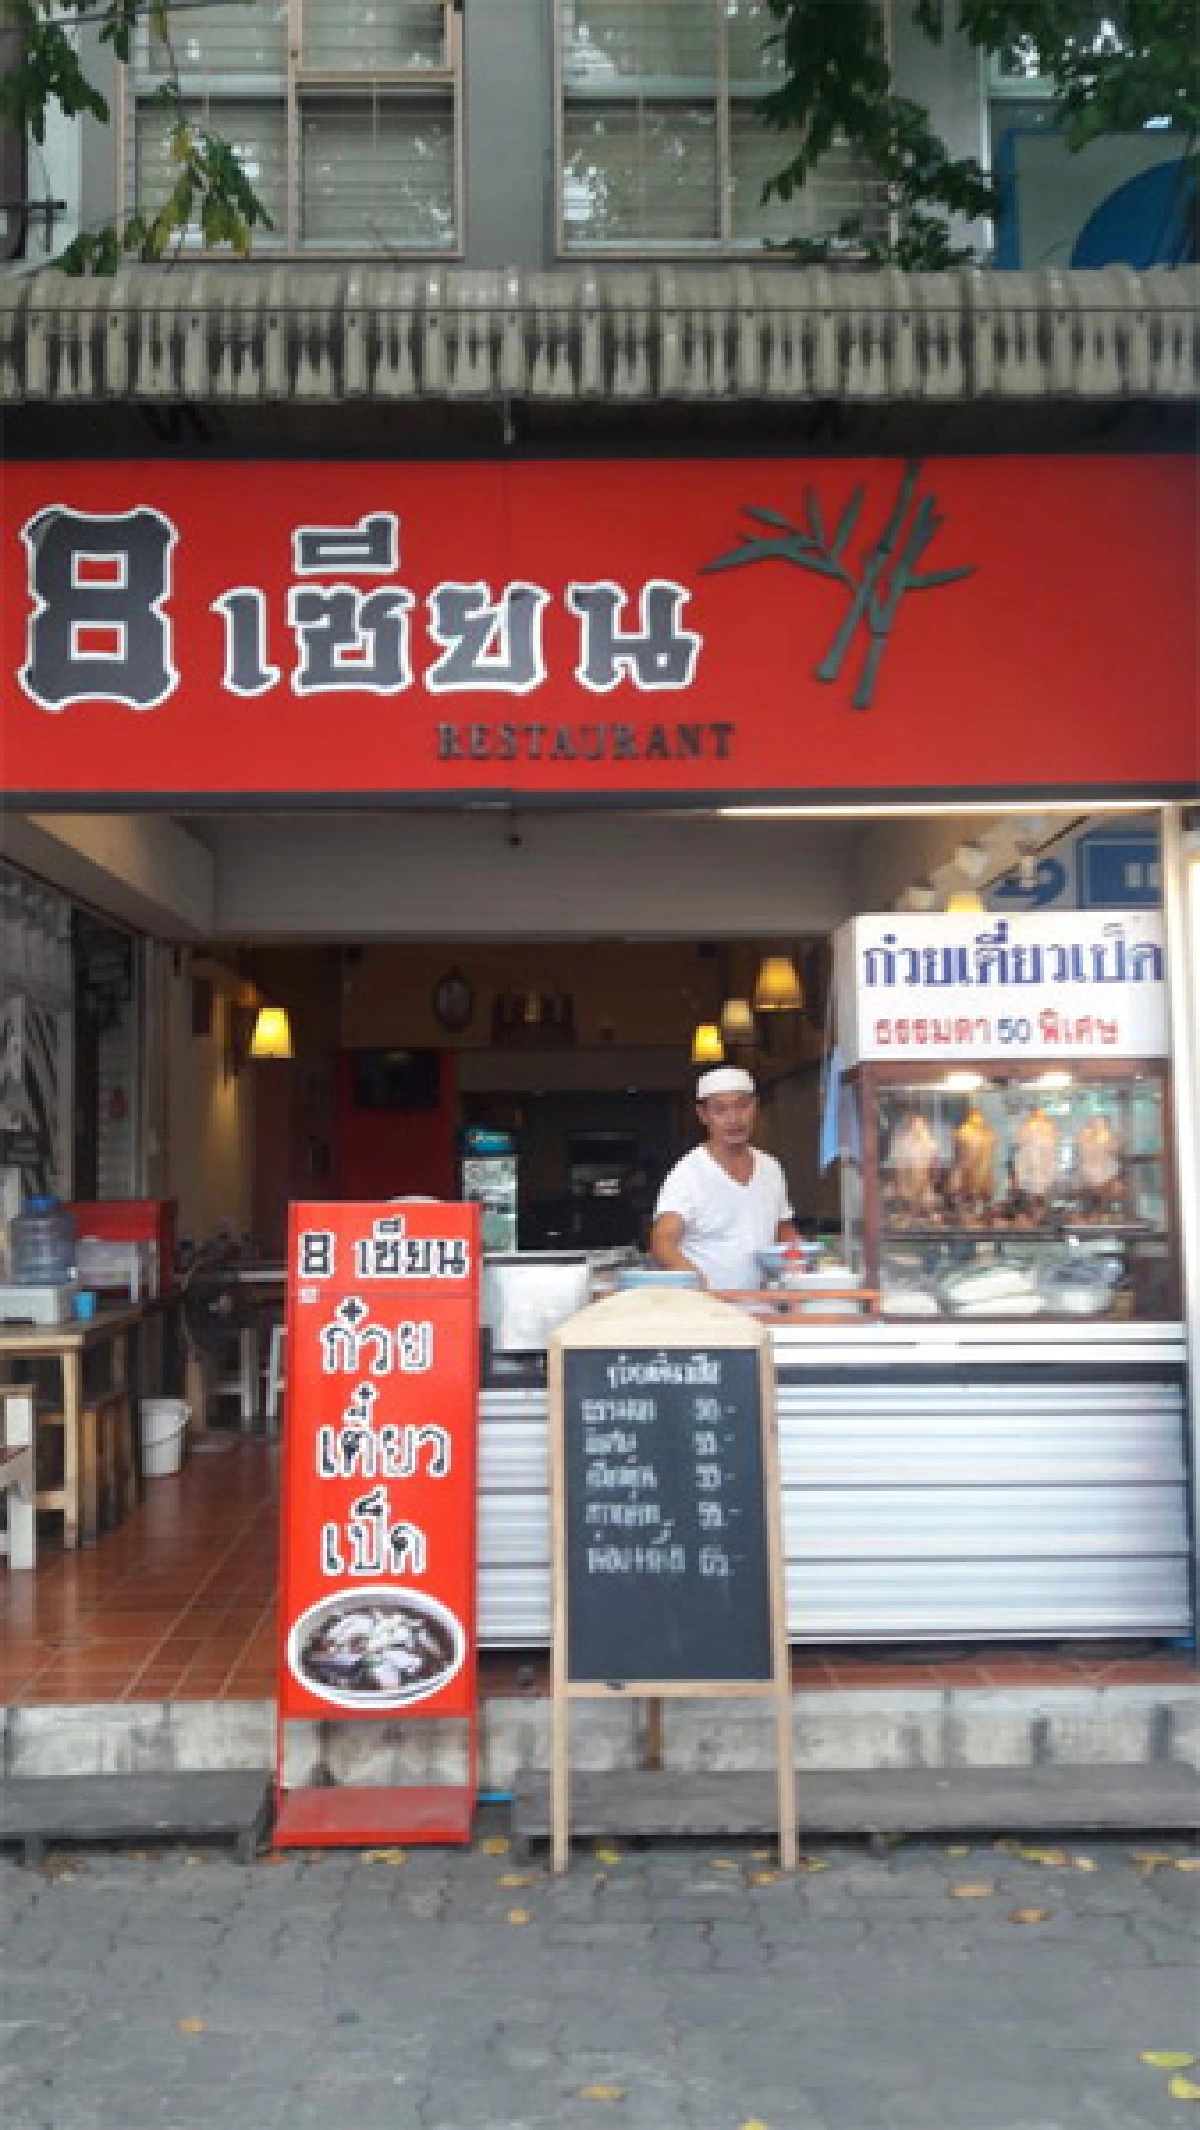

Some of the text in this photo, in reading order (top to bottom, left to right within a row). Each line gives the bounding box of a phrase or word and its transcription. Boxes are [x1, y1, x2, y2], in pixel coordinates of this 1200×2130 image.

[18, 503, 702, 712] 8 เซียน
[435, 721, 735, 761] RESTAURANT
[997, 1018, 1032, 1045] 50
[1036, 1007, 1120, 1045] พิเศษ
[298, 1213, 471, 1280] 8 เซียน
[319, 1296, 434, 1376] ก๋วย
[320, 1484, 428, 1577] เป็ด
